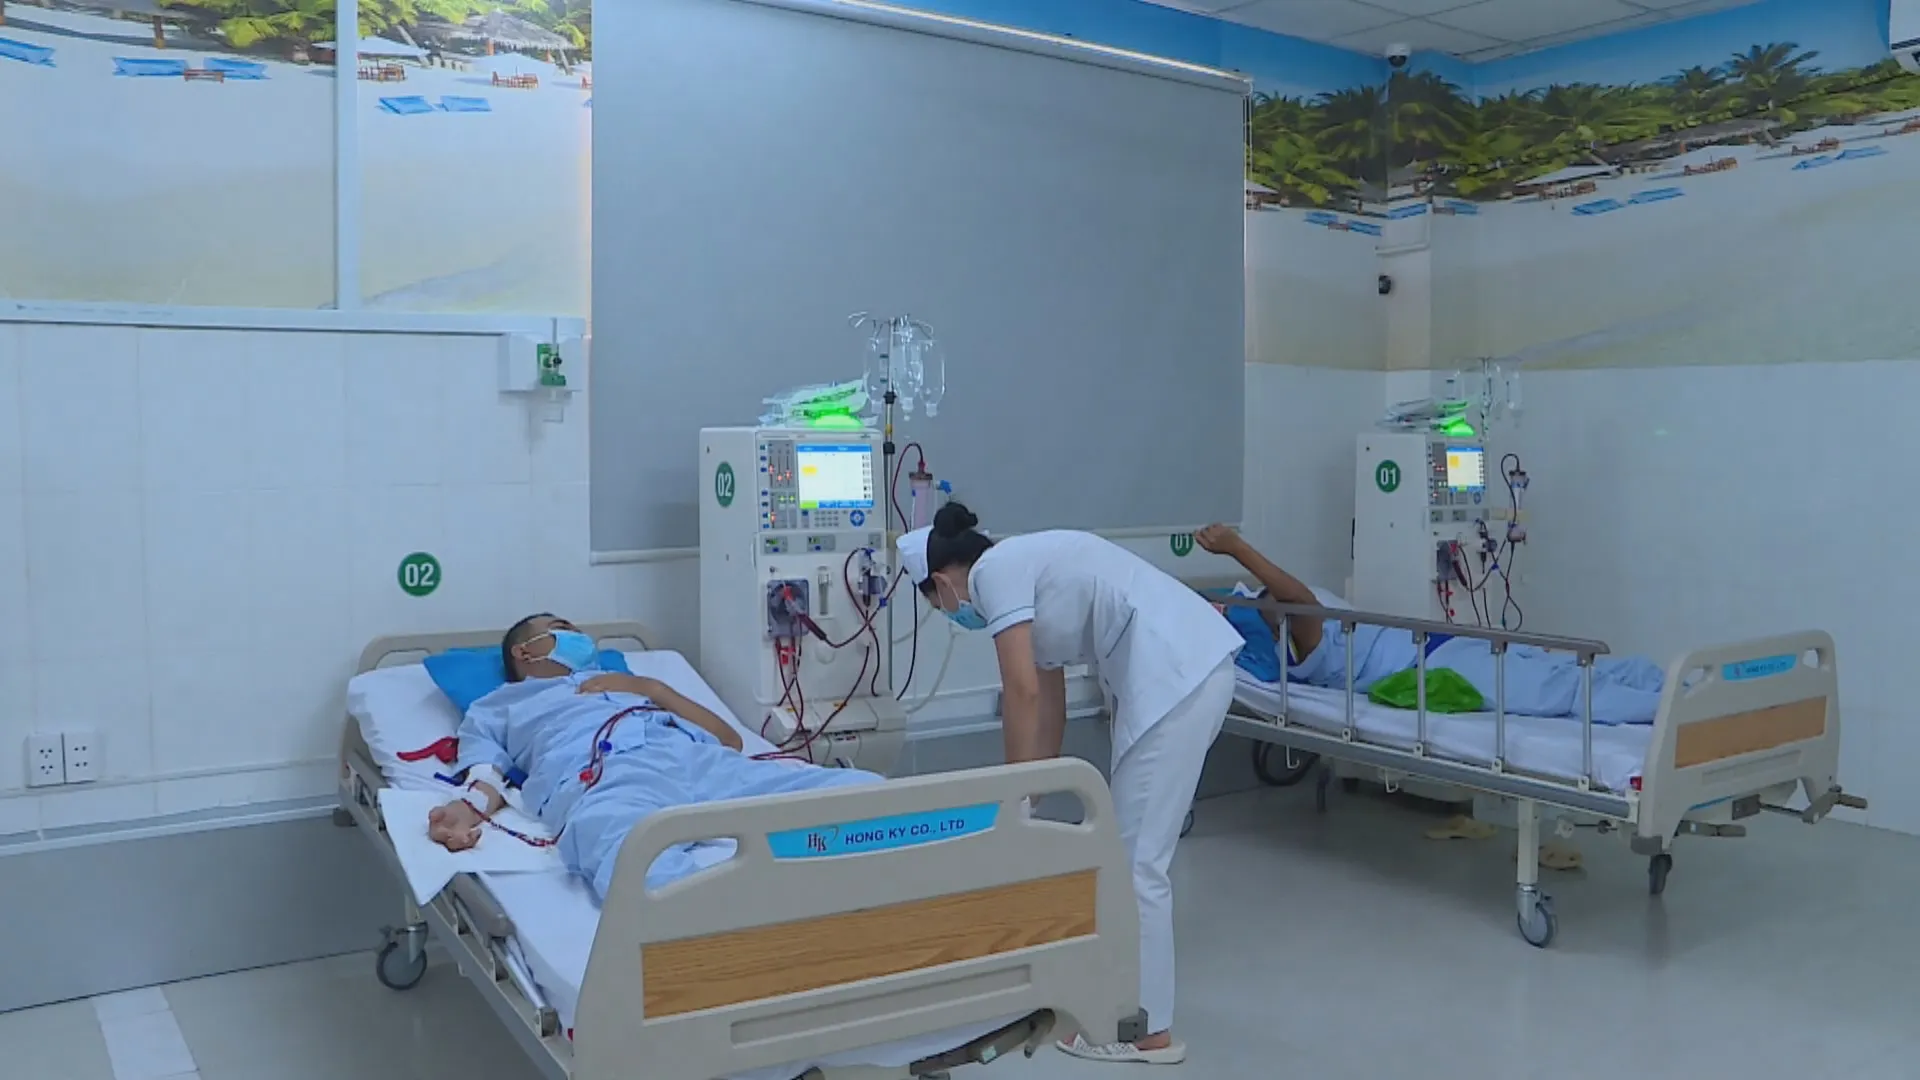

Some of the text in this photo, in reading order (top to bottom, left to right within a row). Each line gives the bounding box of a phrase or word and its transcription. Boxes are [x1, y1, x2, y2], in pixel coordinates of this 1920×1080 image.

[717, 473, 731, 497] 02
[1380, 468, 1396, 485] 01
[405, 562, 434, 587] 02
[845, 829, 885, 846] HONG
[889, 827, 906, 839] KY
[940, 819, 965, 832] LTD
